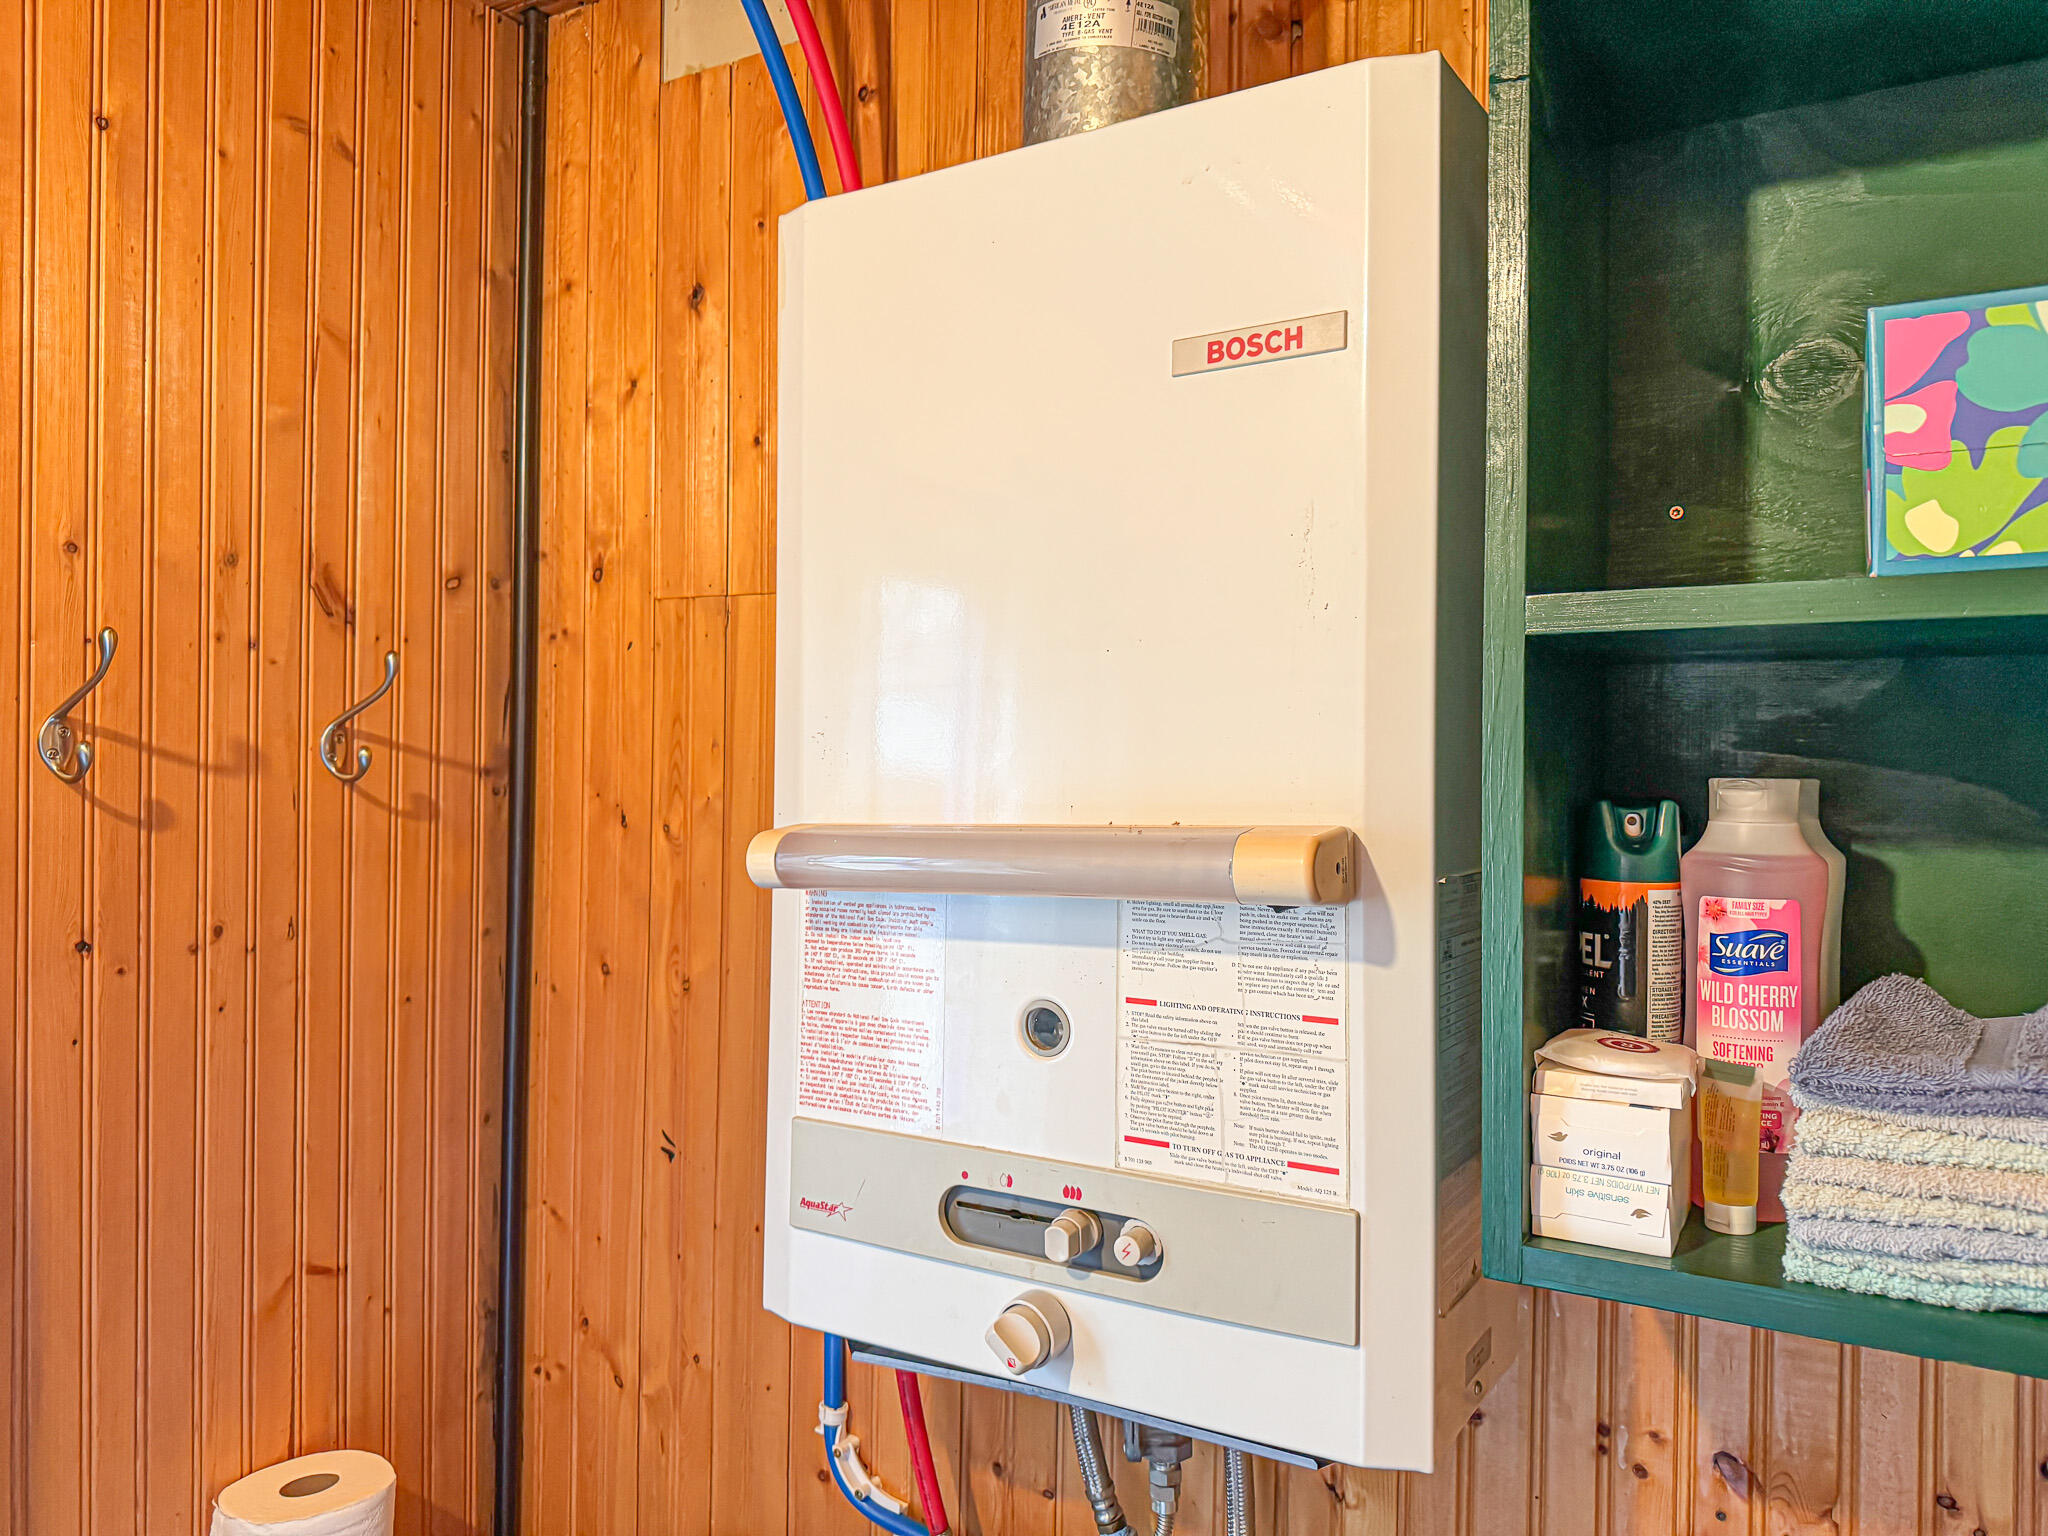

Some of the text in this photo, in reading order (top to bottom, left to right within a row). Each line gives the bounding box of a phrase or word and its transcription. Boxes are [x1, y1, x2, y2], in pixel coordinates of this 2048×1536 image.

[1061, 20, 1100, 31] 4E12A
[1207, 325, 1303, 364] BOSCH
[1732, 901, 1765, 910] FAMILY SIZE
[1712, 935, 1785, 960] Suave
[1721, 959, 1776, 967] ESSENTIALS
[1700, 978, 1733, 1004] WILD
[1738, 983, 1798, 1008] CHERRY
[801, 998, 830, 1009] ATTENTION
[1159, 1000, 1191, 1009] LIGHTING
[1249, 1010, 1301, 1021] INSTRUCTIONS
[1711, 1005, 1784, 1032] BLOSSOM
[1713, 1040, 1774, 1062] SOFTENING
[1183, 1144, 1201, 1153] TURN
[1202, 1147, 1214, 1155] OFF
[1234, 1152, 1244, 1160] TO
[1245, 1154, 1285, 1166] APPLIANCE
[1582, 1148, 1621, 1160] original
[1559, 1157, 1577, 1165] POIDS
[1601, 1163, 1615, 1171] 3.75
[1573, 1174, 1588, 1183] 3.75
[1590, 1177, 1605, 1186] NET
[1607, 1180, 1643, 1193] WT/POIDS
[1646, 1187, 1660, 1195] NET
[1565, 1186, 1630, 1204] sensitive skin
[800, 1197, 839, 1212] AquaStar
